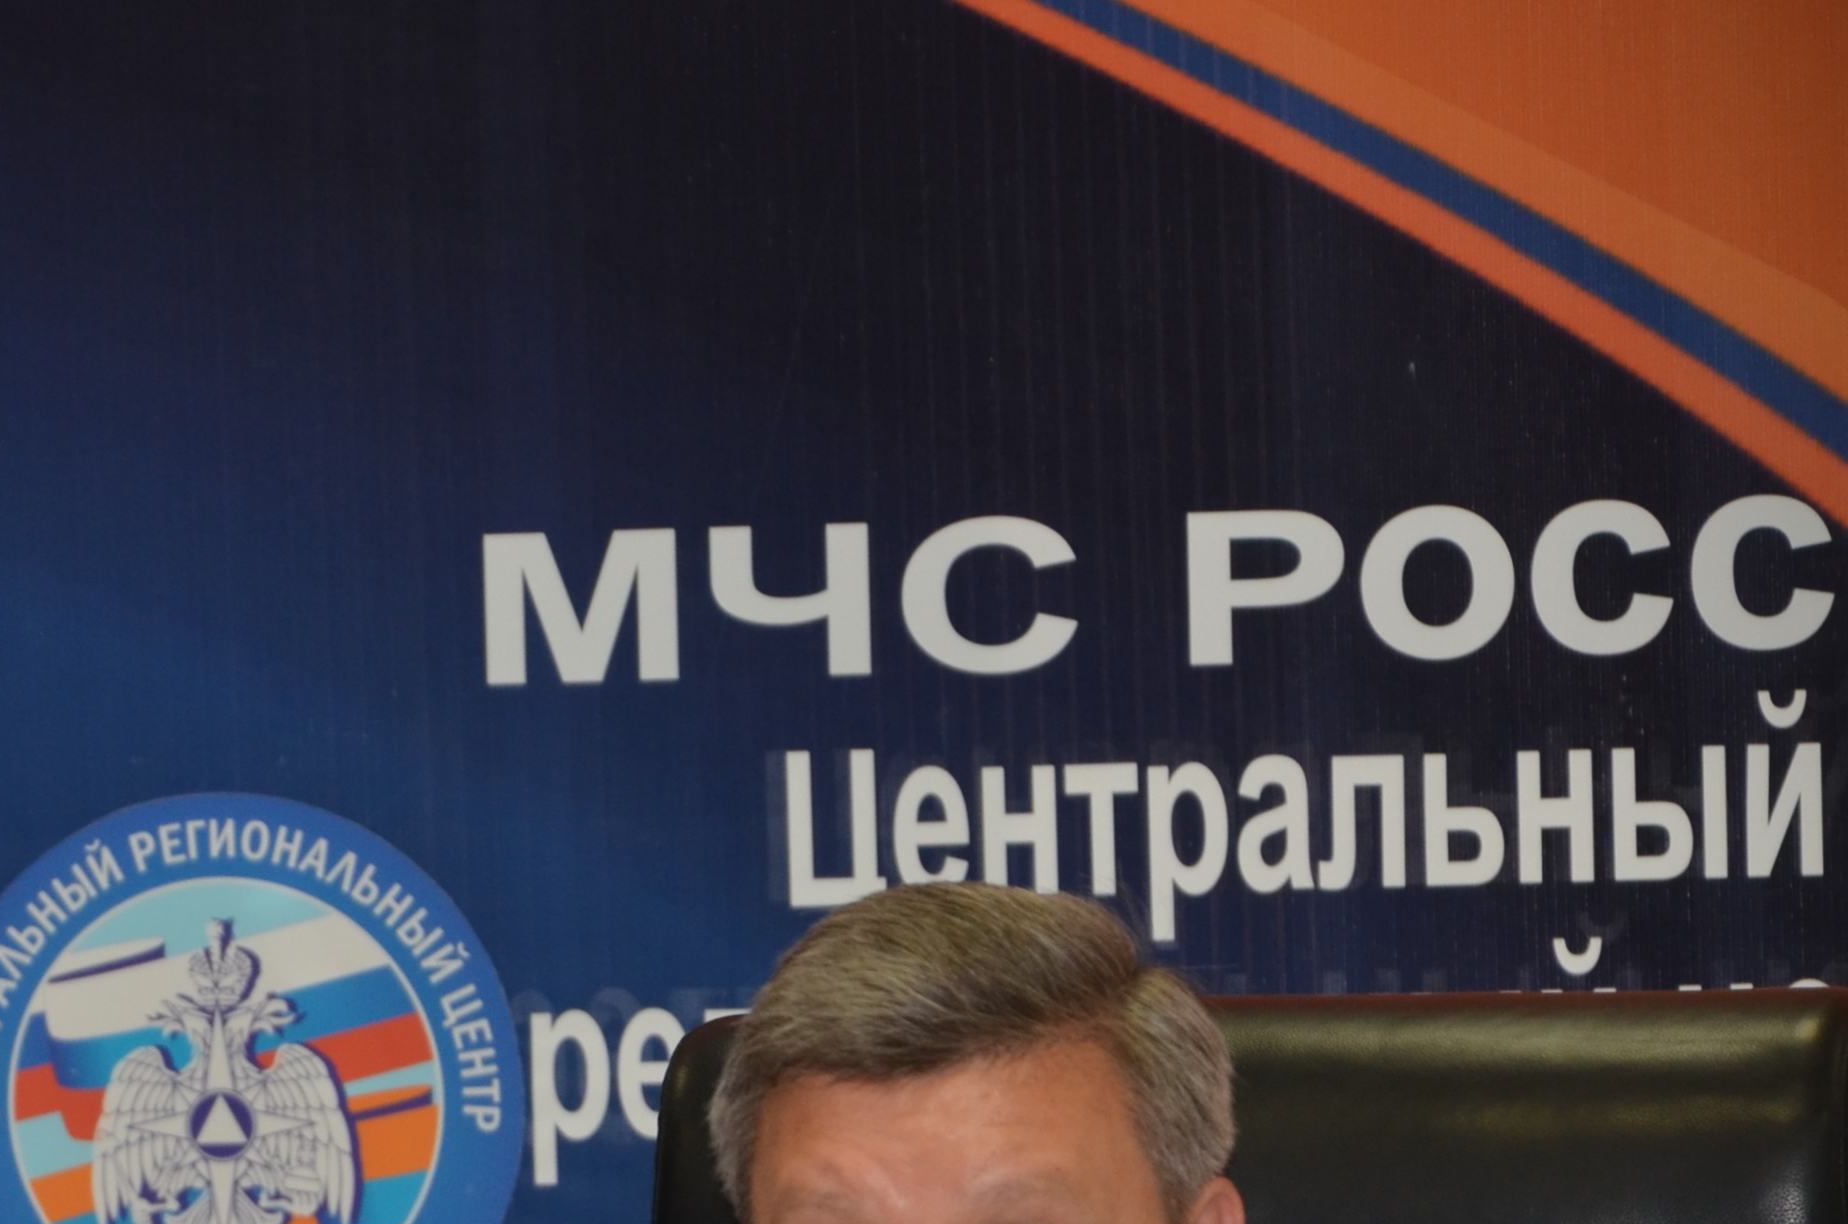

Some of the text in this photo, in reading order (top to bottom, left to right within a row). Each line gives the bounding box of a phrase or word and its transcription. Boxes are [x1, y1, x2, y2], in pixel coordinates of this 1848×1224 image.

[483, 494, 1836, 686] МЧС РОСС
[785, 688, 1825, 941] Центральный
[127, 817, 471, 985] РЕГИОНАЛЬНЫЙ
[440, 982, 502, 1134] ЦЕНТР
